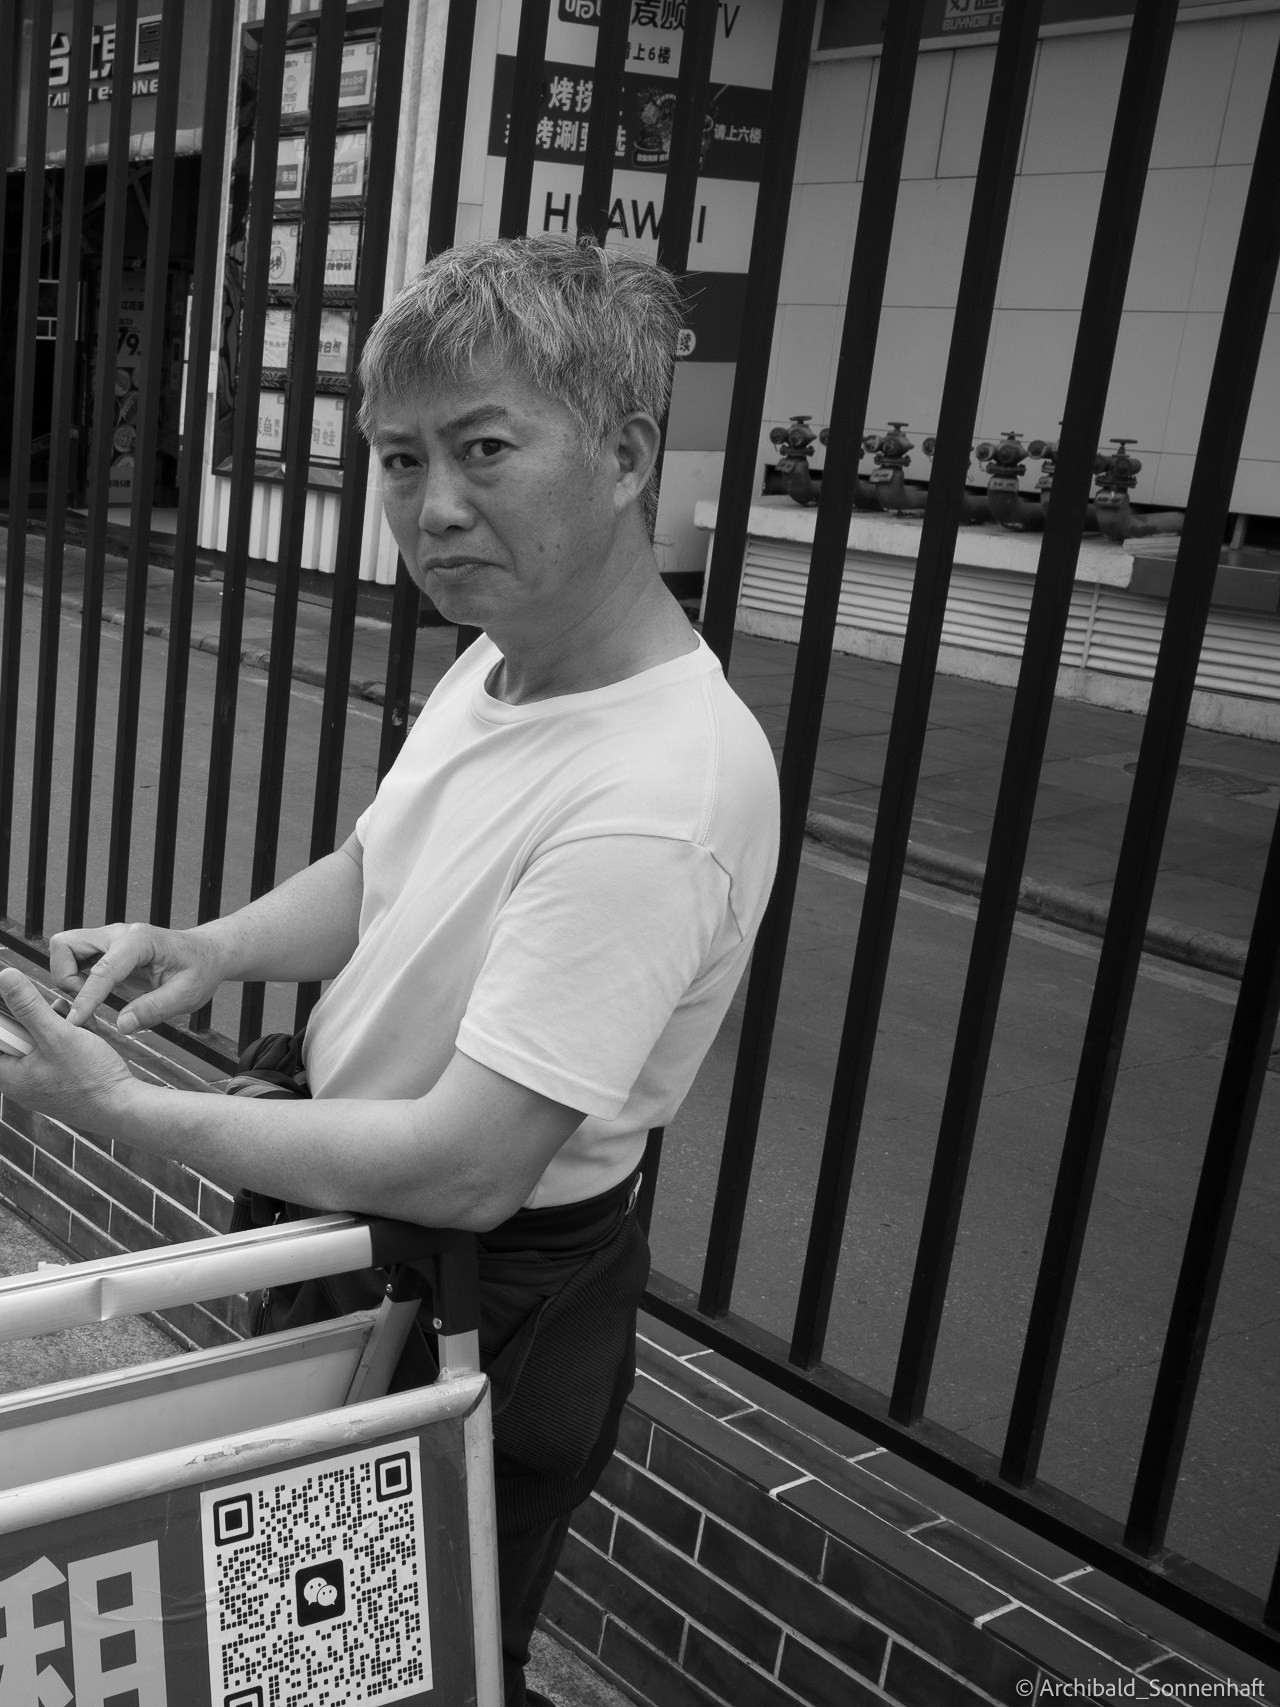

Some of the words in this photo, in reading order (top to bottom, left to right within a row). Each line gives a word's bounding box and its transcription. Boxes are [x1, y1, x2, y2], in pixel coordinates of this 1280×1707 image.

[714, 123, 762, 145] 请上六楼
[543, 191, 707, 243] HAWI
